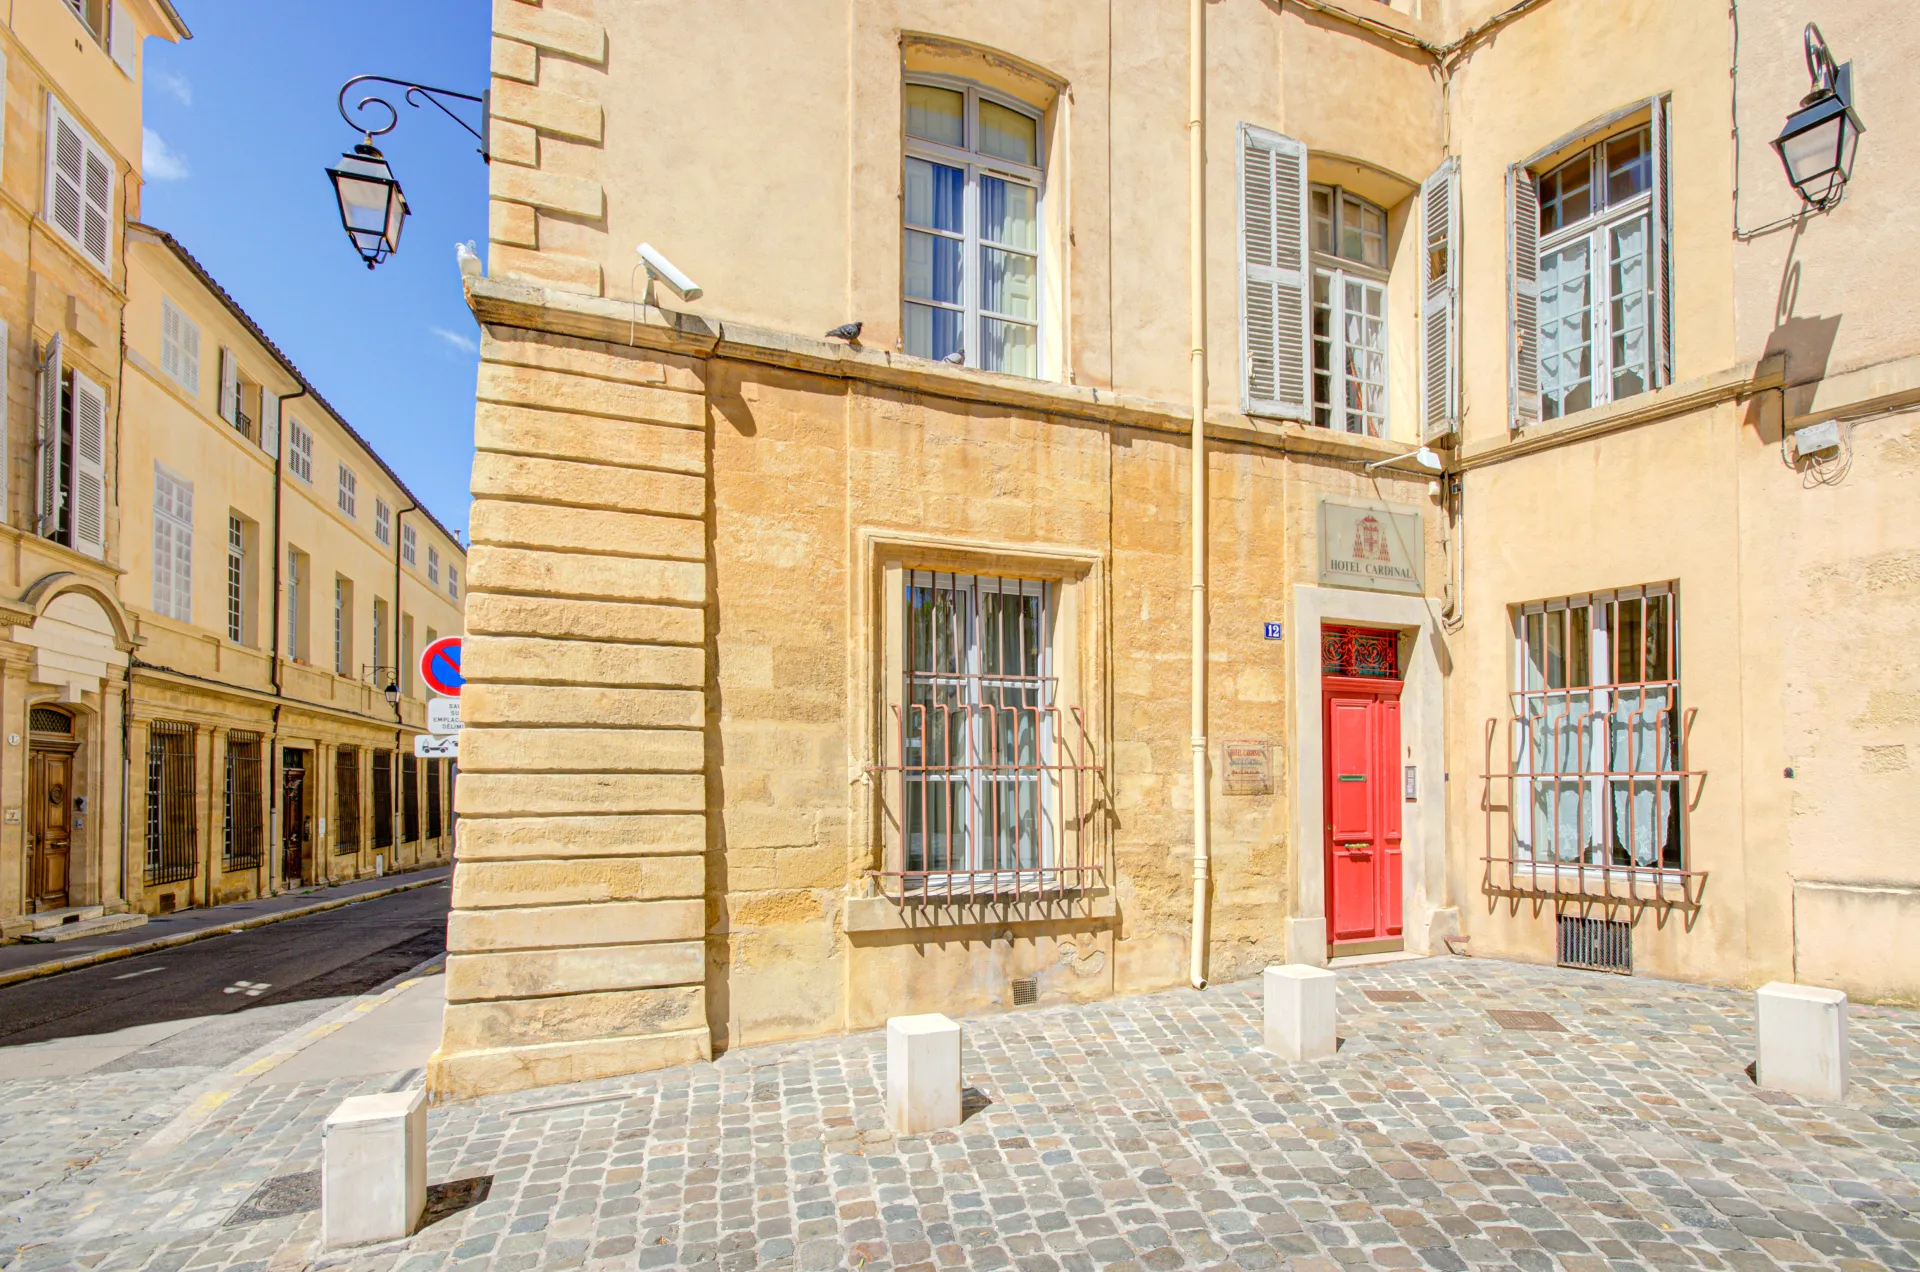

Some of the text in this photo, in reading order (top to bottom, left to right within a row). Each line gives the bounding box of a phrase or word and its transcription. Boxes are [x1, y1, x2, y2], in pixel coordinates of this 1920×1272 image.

[1330, 559, 1412, 579] HOTEL CARDINAL
[1268, 624, 1280, 637] 12
